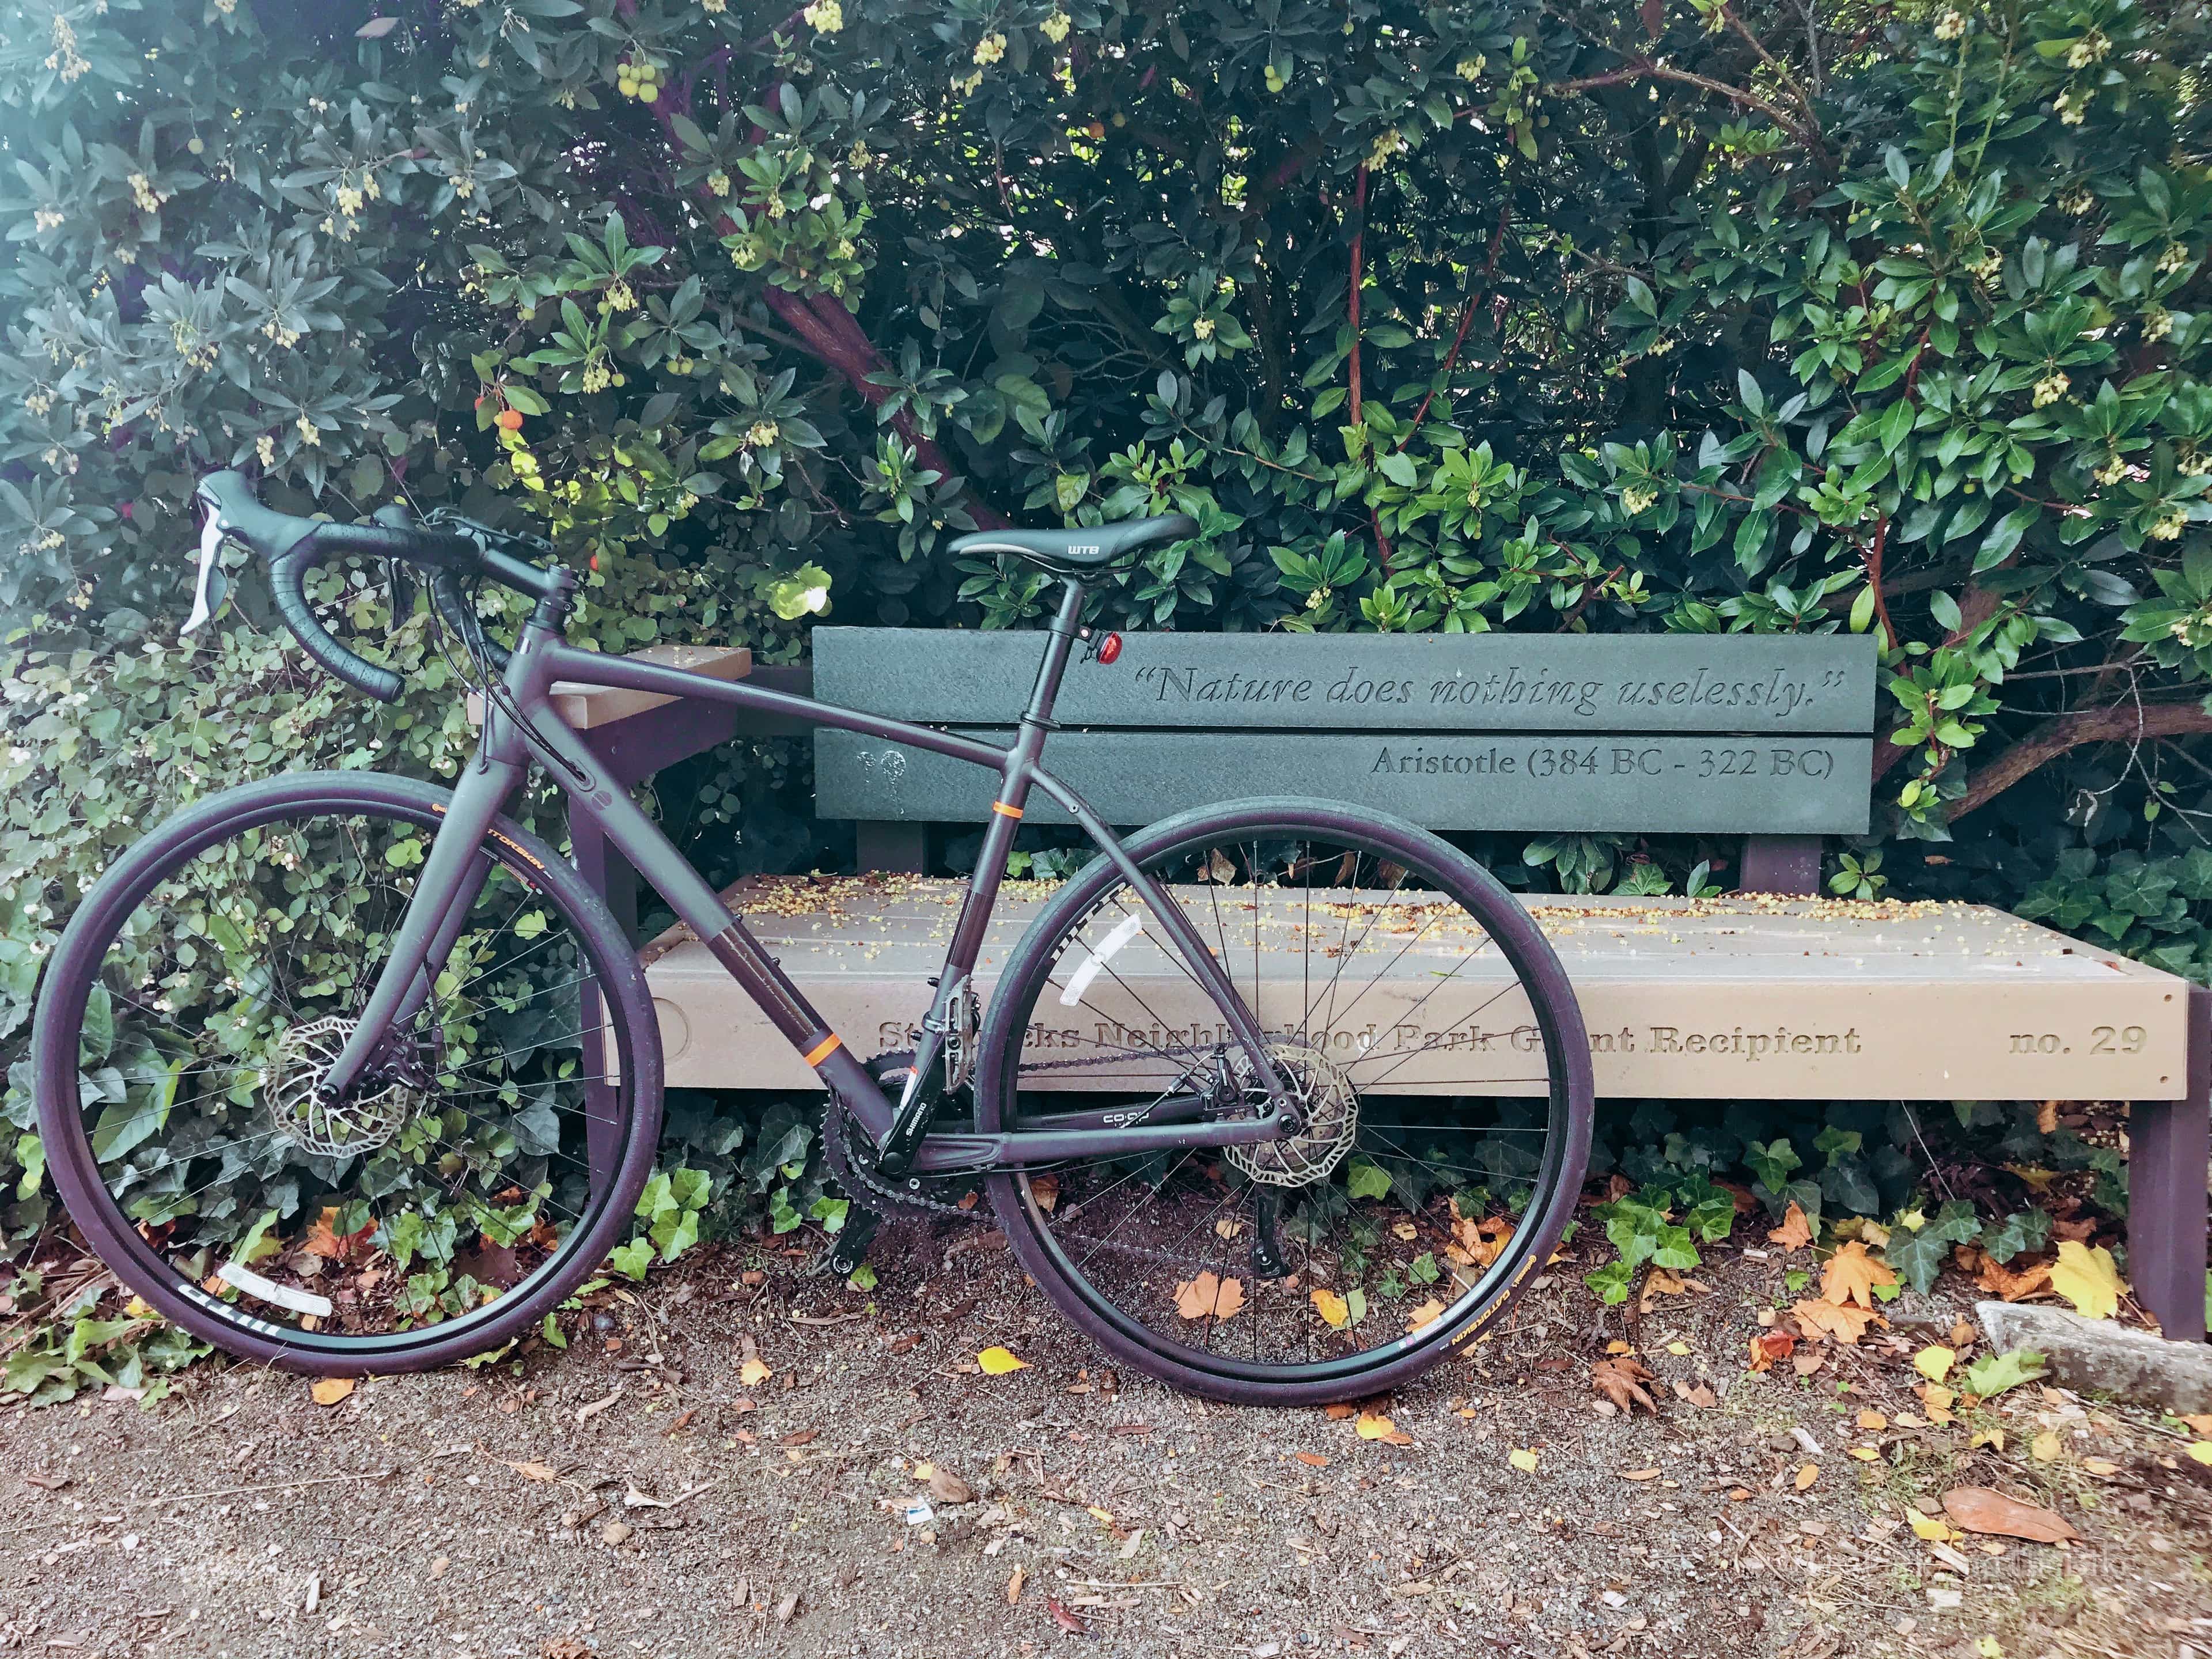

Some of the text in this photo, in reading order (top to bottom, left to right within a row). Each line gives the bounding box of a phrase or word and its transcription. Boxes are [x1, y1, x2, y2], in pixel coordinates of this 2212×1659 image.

[1067, 545, 1100, 555] WTB
[1135, 666, 1313, 703] “Nature
[1326, 666, 1414, 704] does
[1429, 666, 1604, 717] nothing
[1370, 746, 1516, 775] Aristotle
[1527, 745, 1599, 778] (384
[1610, 748, 1662, 775] BC
[1698, 749, 1758, 778] 322
[1769, 749, 1834, 780] BC)
[1393, 1024, 1496, 1052] Park
[1510, 1025, 1635, 1053] Gnt
[1650, 1027, 1862, 1063] Recipient
[2008, 1025, 2147, 1055] no. 29
[906, 1102, 927, 1137] SHIMANO
